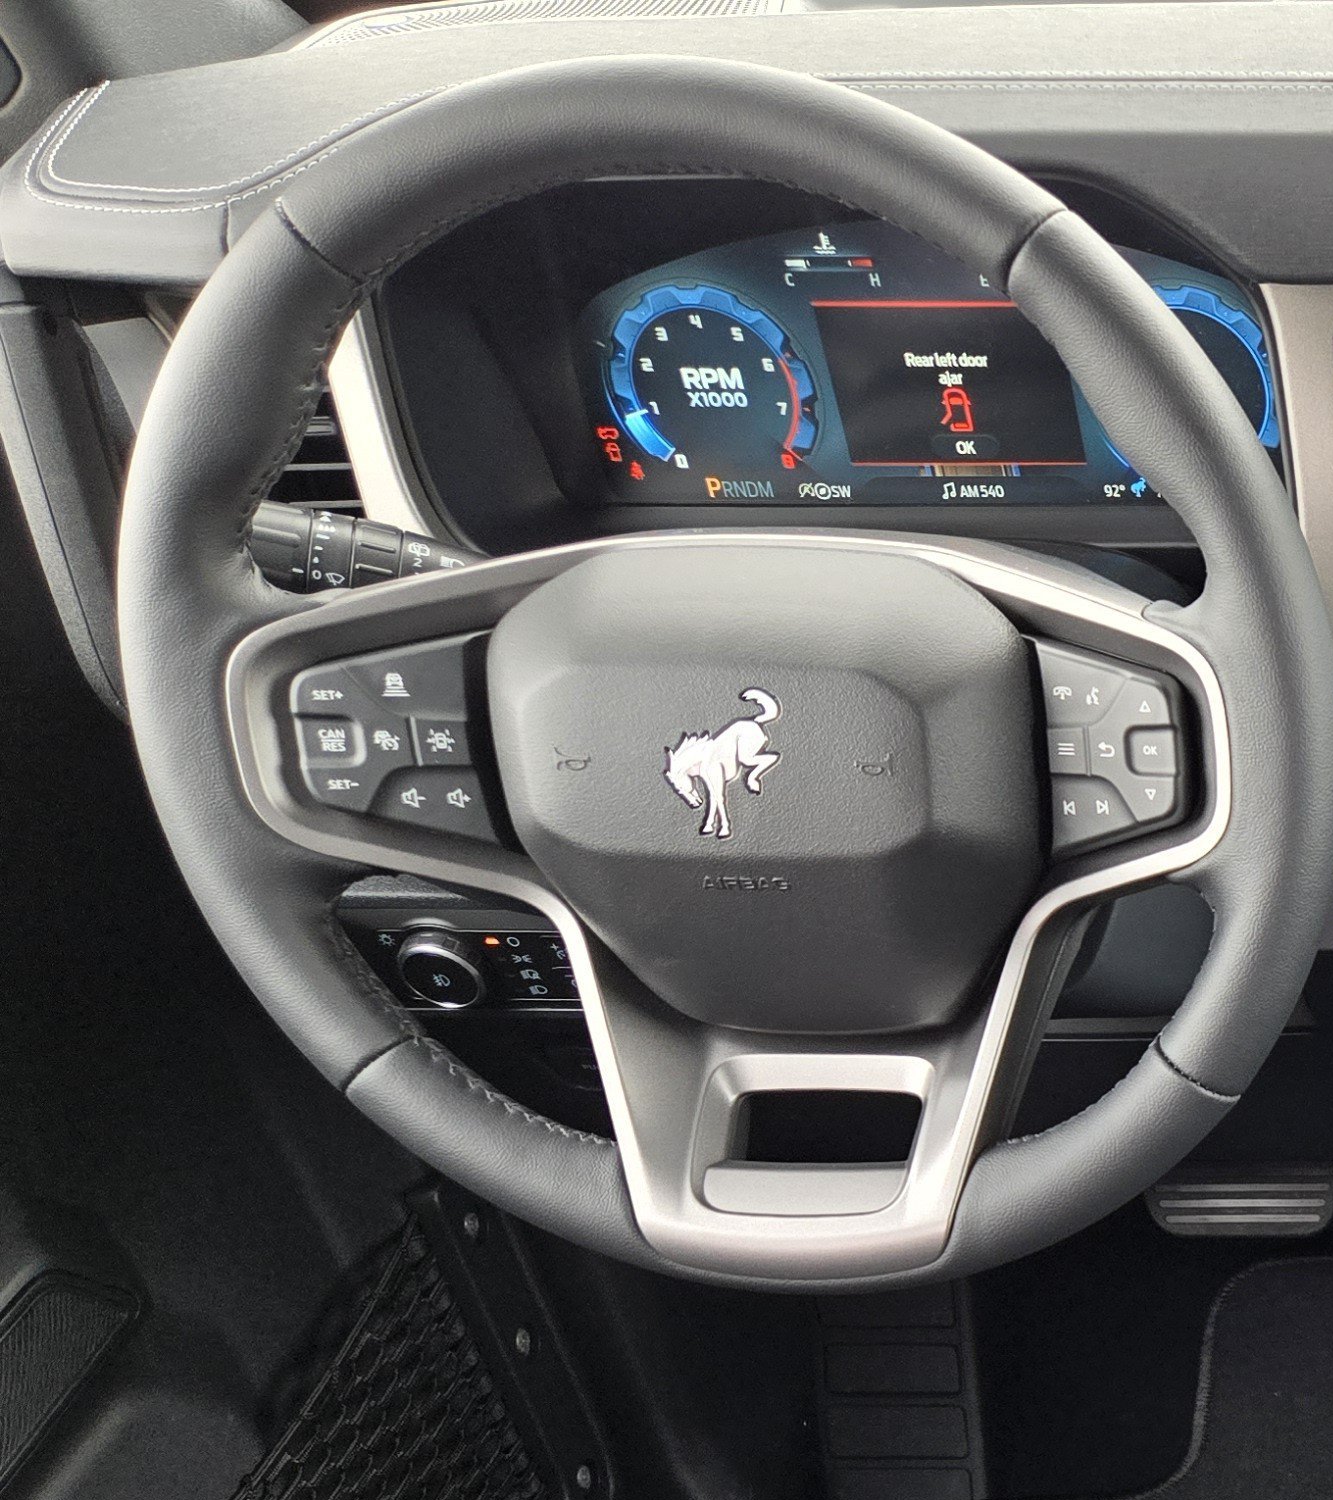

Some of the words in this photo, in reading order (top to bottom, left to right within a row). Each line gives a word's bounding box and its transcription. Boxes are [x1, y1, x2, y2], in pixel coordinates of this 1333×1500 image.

[785, 273, 795, 287] C
[869, 273, 882, 287] H
[689, 315, 703, 330] 4
[655, 327, 669, 342] 3
[731, 327, 744, 342] 5
[640, 358, 655, 373] 2
[762, 358, 776, 373] 6
[903, 352, 934, 368] Rear
[934, 352, 958, 368] left
[958, 352, 988, 368] door
[679, 367, 745, 391] RPM
[938, 370, 963, 387] ajar
[687, 392, 748, 409] X1000
[648, 401, 661, 416] 1
[776, 402, 787, 416] 7
[955, 441, 976, 455] OK
[675, 454, 689, 469] 0
[781, 453, 796, 470] 8
[831, 485, 851, 498] SW
[960, 485, 980, 498] AM
[980, 485, 1004, 498] 540
[1104, 484, 1125, 498] 92°
[317, 729, 346, 739] CAN
[321, 742, 346, 752] RES
[1143, 746, 1158, 756] OK
[702, 875, 790, 891] AIRBAG
